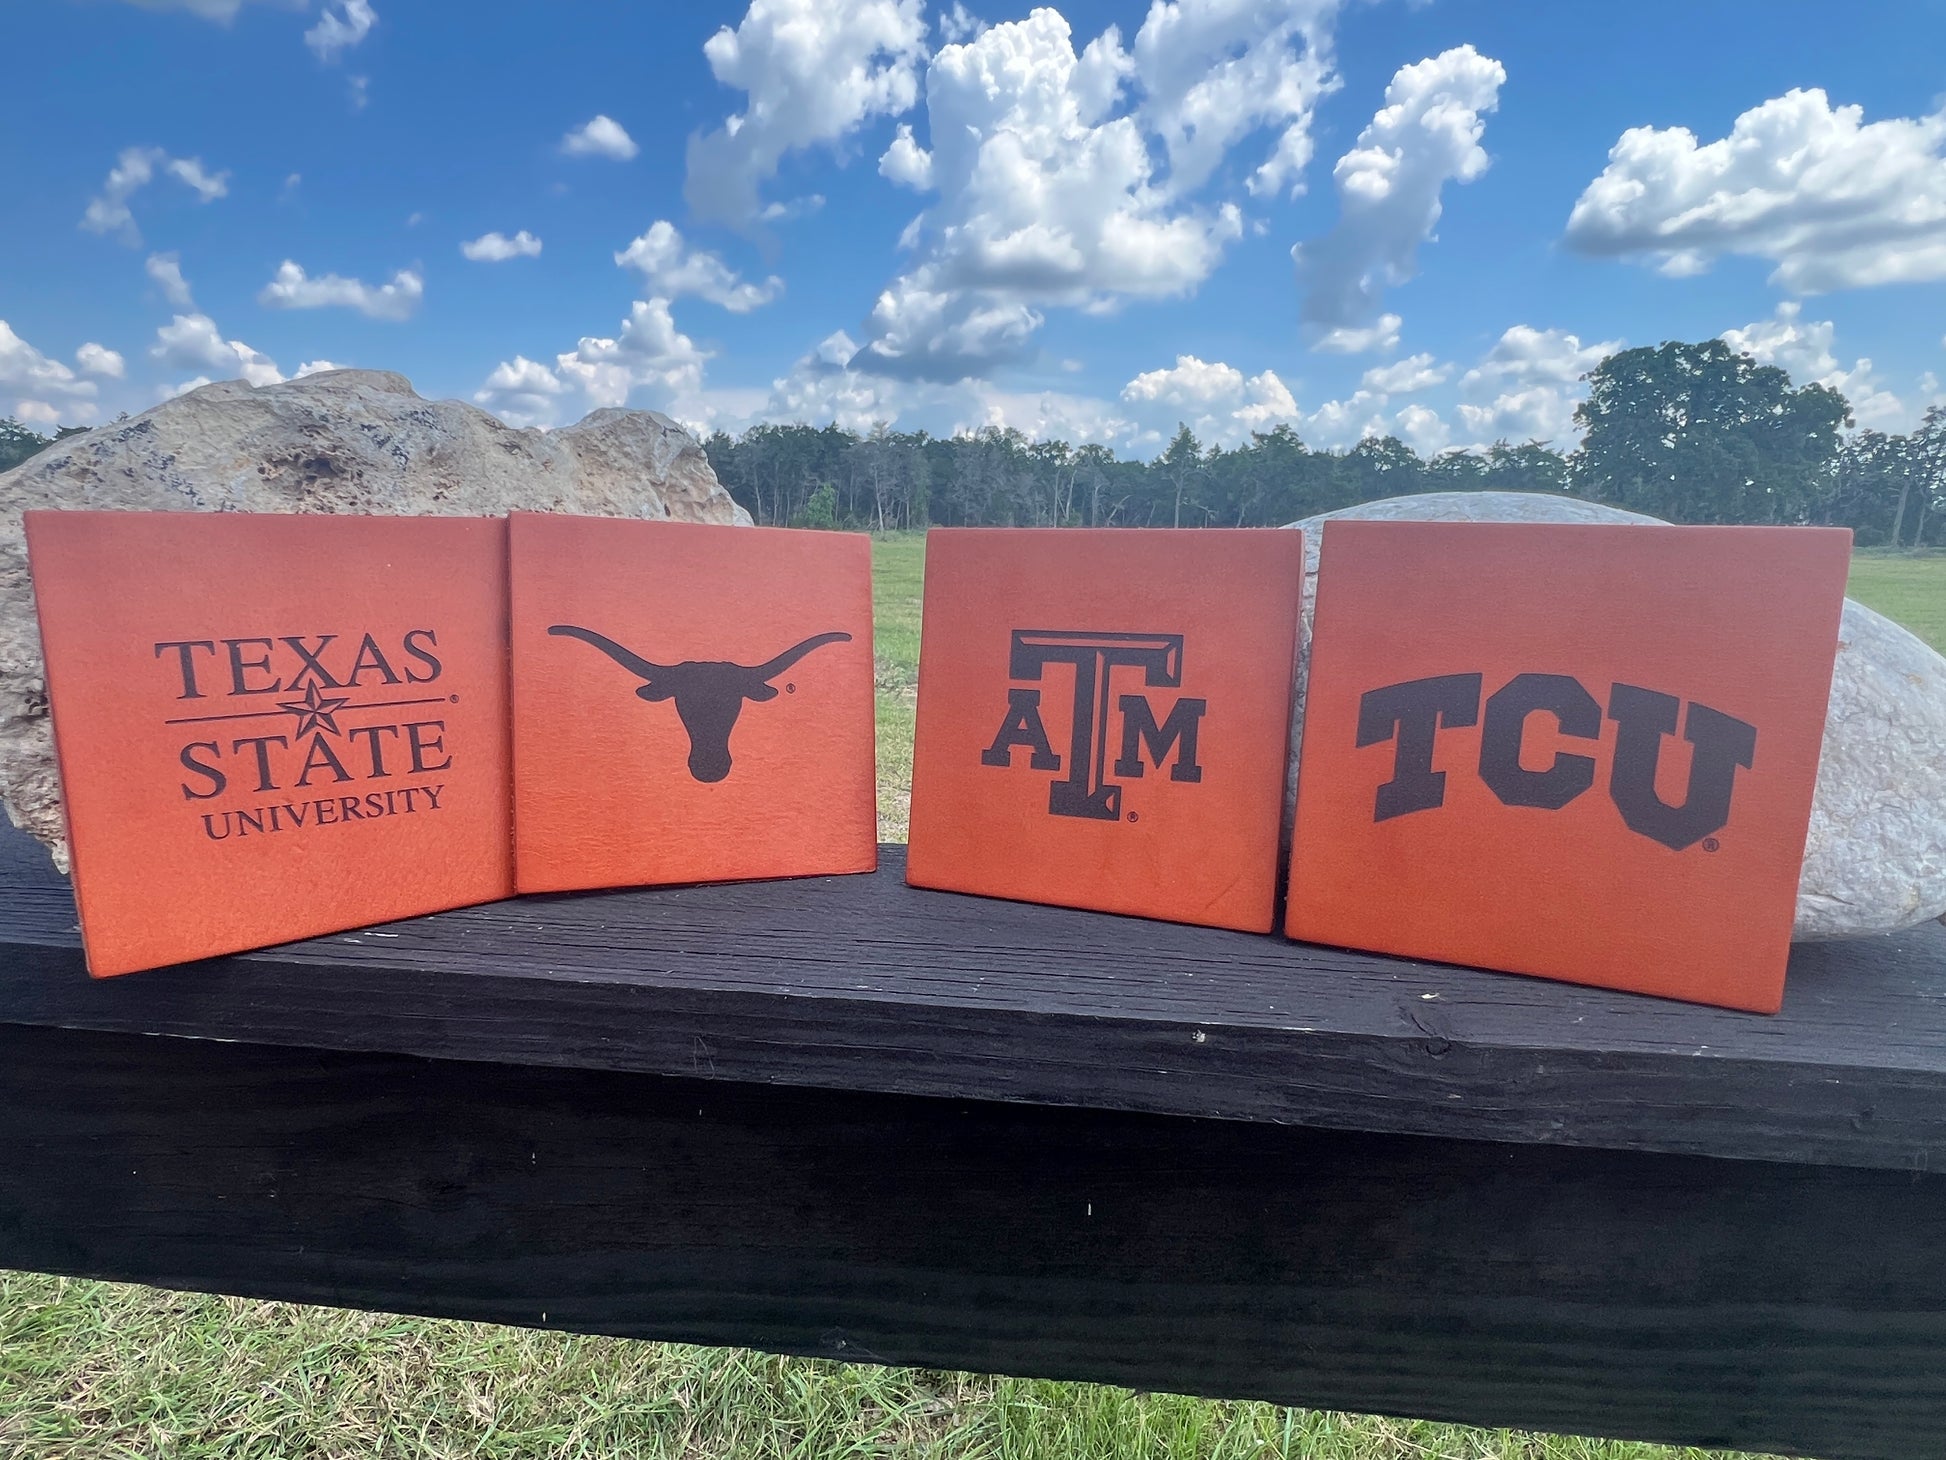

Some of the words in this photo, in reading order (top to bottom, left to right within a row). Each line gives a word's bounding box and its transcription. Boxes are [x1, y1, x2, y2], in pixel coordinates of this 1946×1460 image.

[154, 629, 443, 700] TEXAS
[179, 720, 453, 801] STATE
[1355, 672, 1758, 852] TCU
[201, 784, 445, 841] UNIVERSITY
